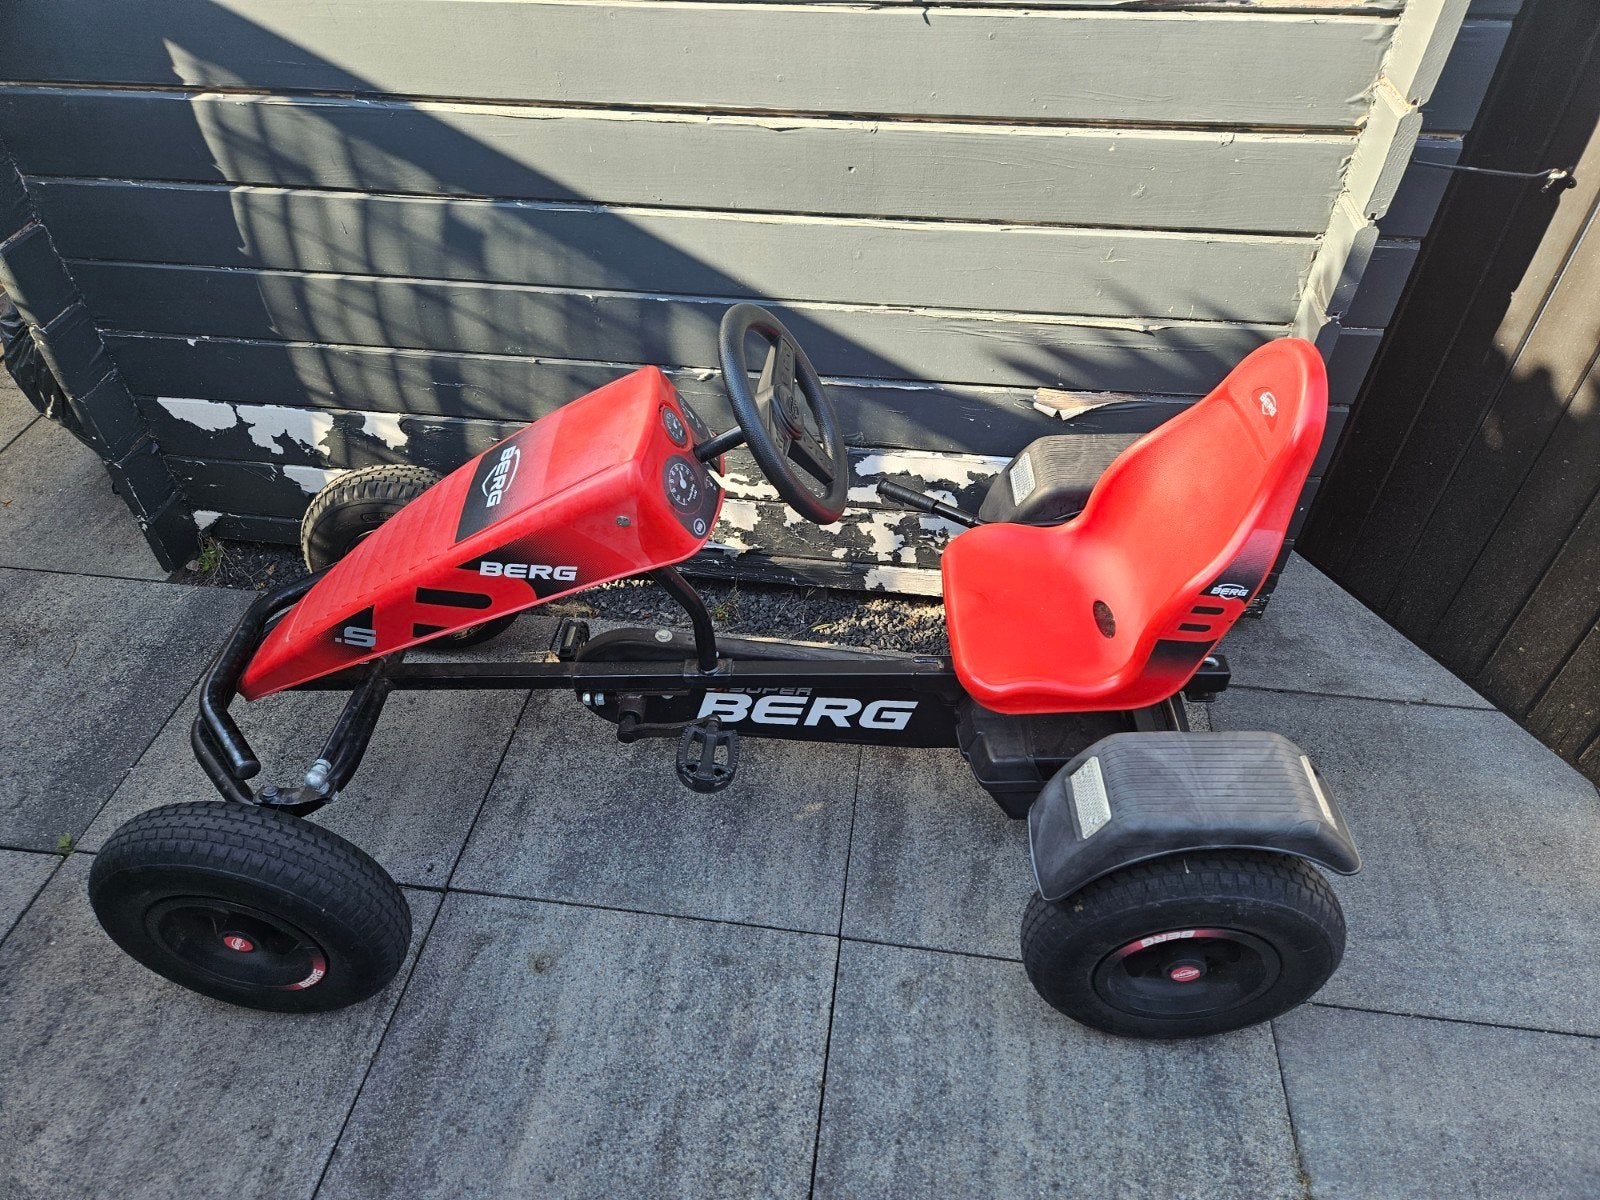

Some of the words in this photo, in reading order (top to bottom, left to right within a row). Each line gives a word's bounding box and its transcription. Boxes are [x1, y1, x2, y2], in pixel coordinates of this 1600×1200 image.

[486, 446, 516, 507] BERG
[479, 561, 578, 581] BERG
[1210, 587, 1249, 597] BERG
[696, 692, 919, 731] BERG
[1140, 930, 1195, 948] BERG
[298, 968, 324, 988] BERG
